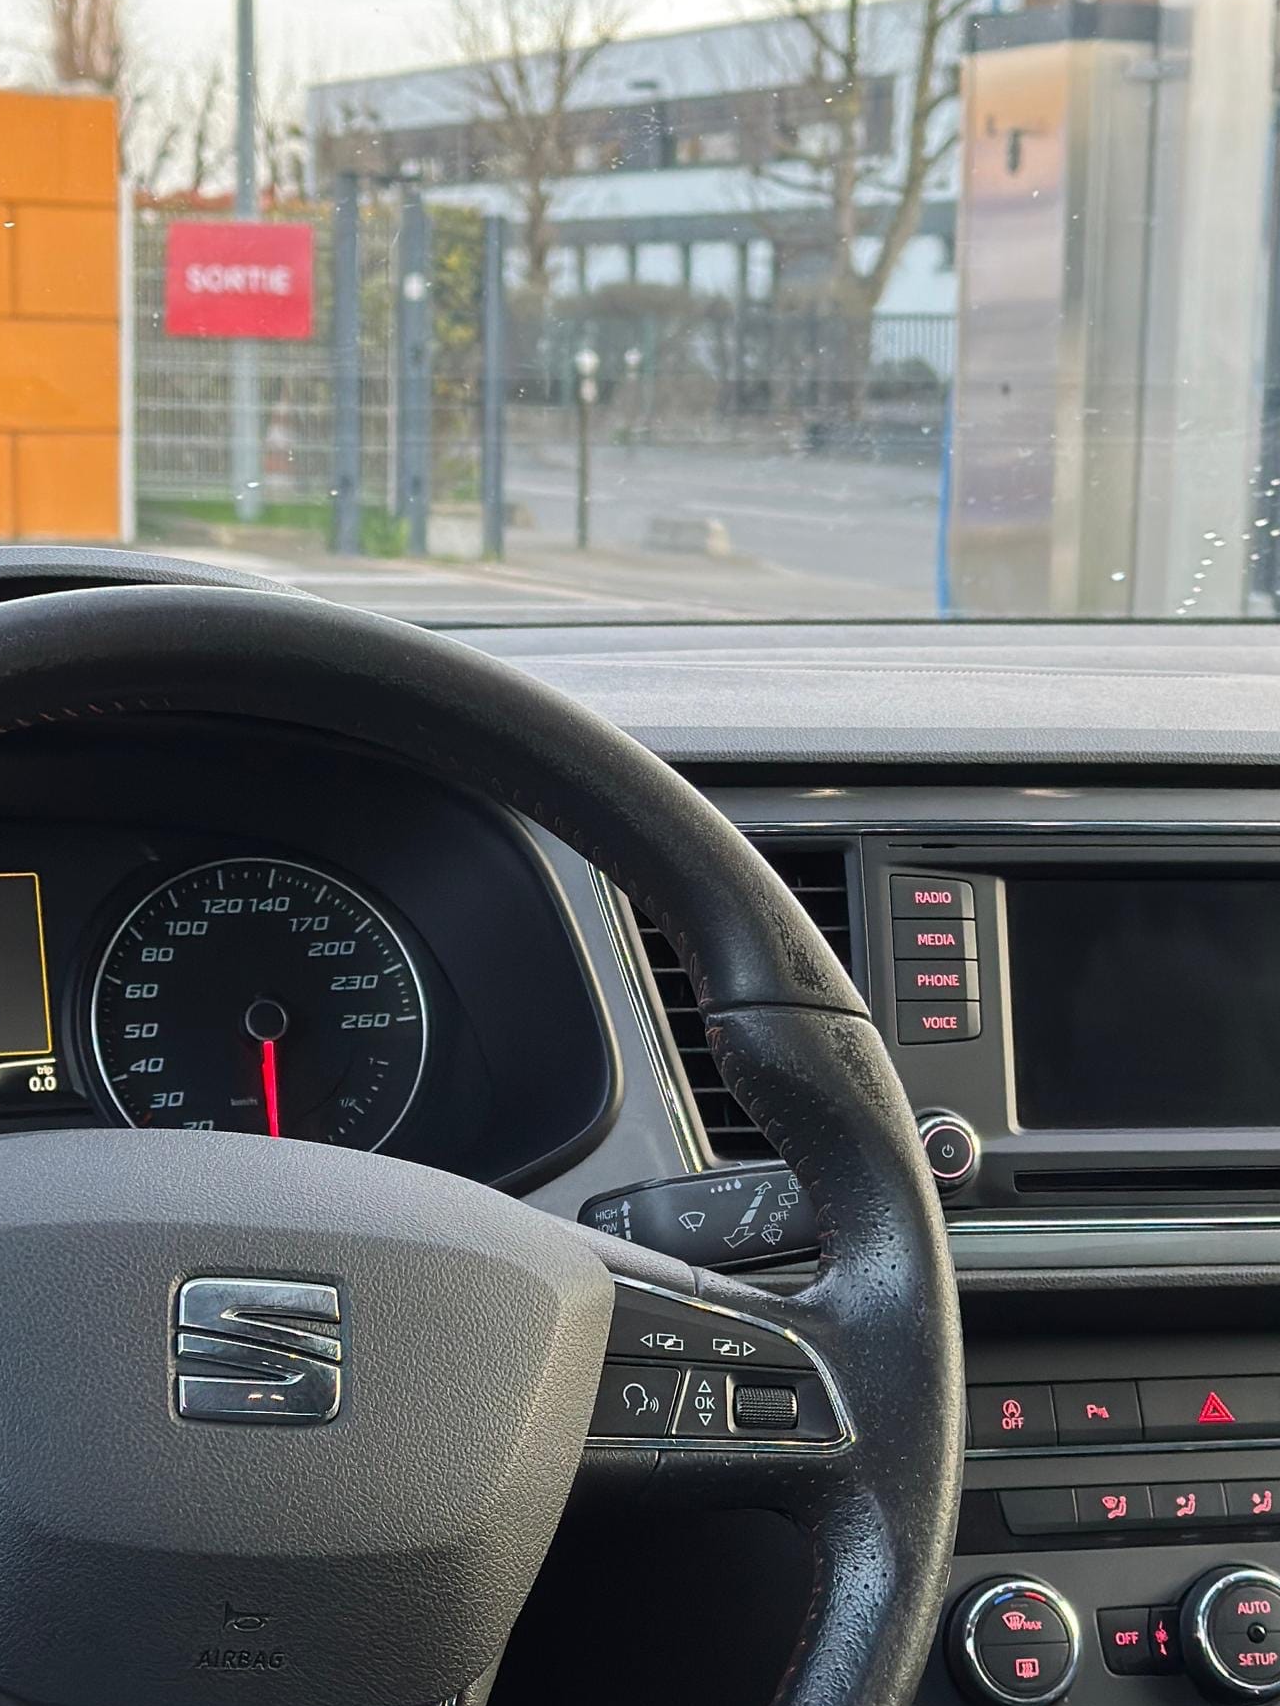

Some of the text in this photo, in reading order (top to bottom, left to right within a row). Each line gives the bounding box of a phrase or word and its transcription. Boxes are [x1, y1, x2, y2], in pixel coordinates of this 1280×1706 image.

[185, 264, 289, 295] SORTIE
[248, 897, 290, 913] 140
[915, 892, 952, 904] RADIO
[201, 899, 243, 914] 120
[164, 921, 208, 936] 100
[288, 916, 330, 932] 170
[917, 934, 956, 946] MEDIA
[141, 947, 174, 962] 80
[308, 940, 356, 957] 200
[330, 974, 378, 991] 230
[917, 974, 960, 987] PHONE
[124, 983, 158, 999] 60
[341, 1013, 390, 1029] 260
[922, 1016, 958, 1029] VOICE
[123, 1023, 158, 1039] 50
[36, 1065, 54, 1076] trip
[129, 1057, 164, 1073] 40
[28, 1076, 56, 1091] 0.0
[150, 1091, 184, 1109] 30
[769, 1209, 790, 1222] OFF
[597, 1221, 618, 1233] OW
[695, 1396, 716, 1410] OK
[1002, 1417, 1024, 1430] OFF
[1237, 1600, 1271, 1615] AUTO
[1023, 1620, 1042, 1630] MAX
[1115, 1631, 1139, 1646] OFF
[194, 1649, 285, 1671] AIRBAG
[1238, 1652, 1278, 1667] SETUP
